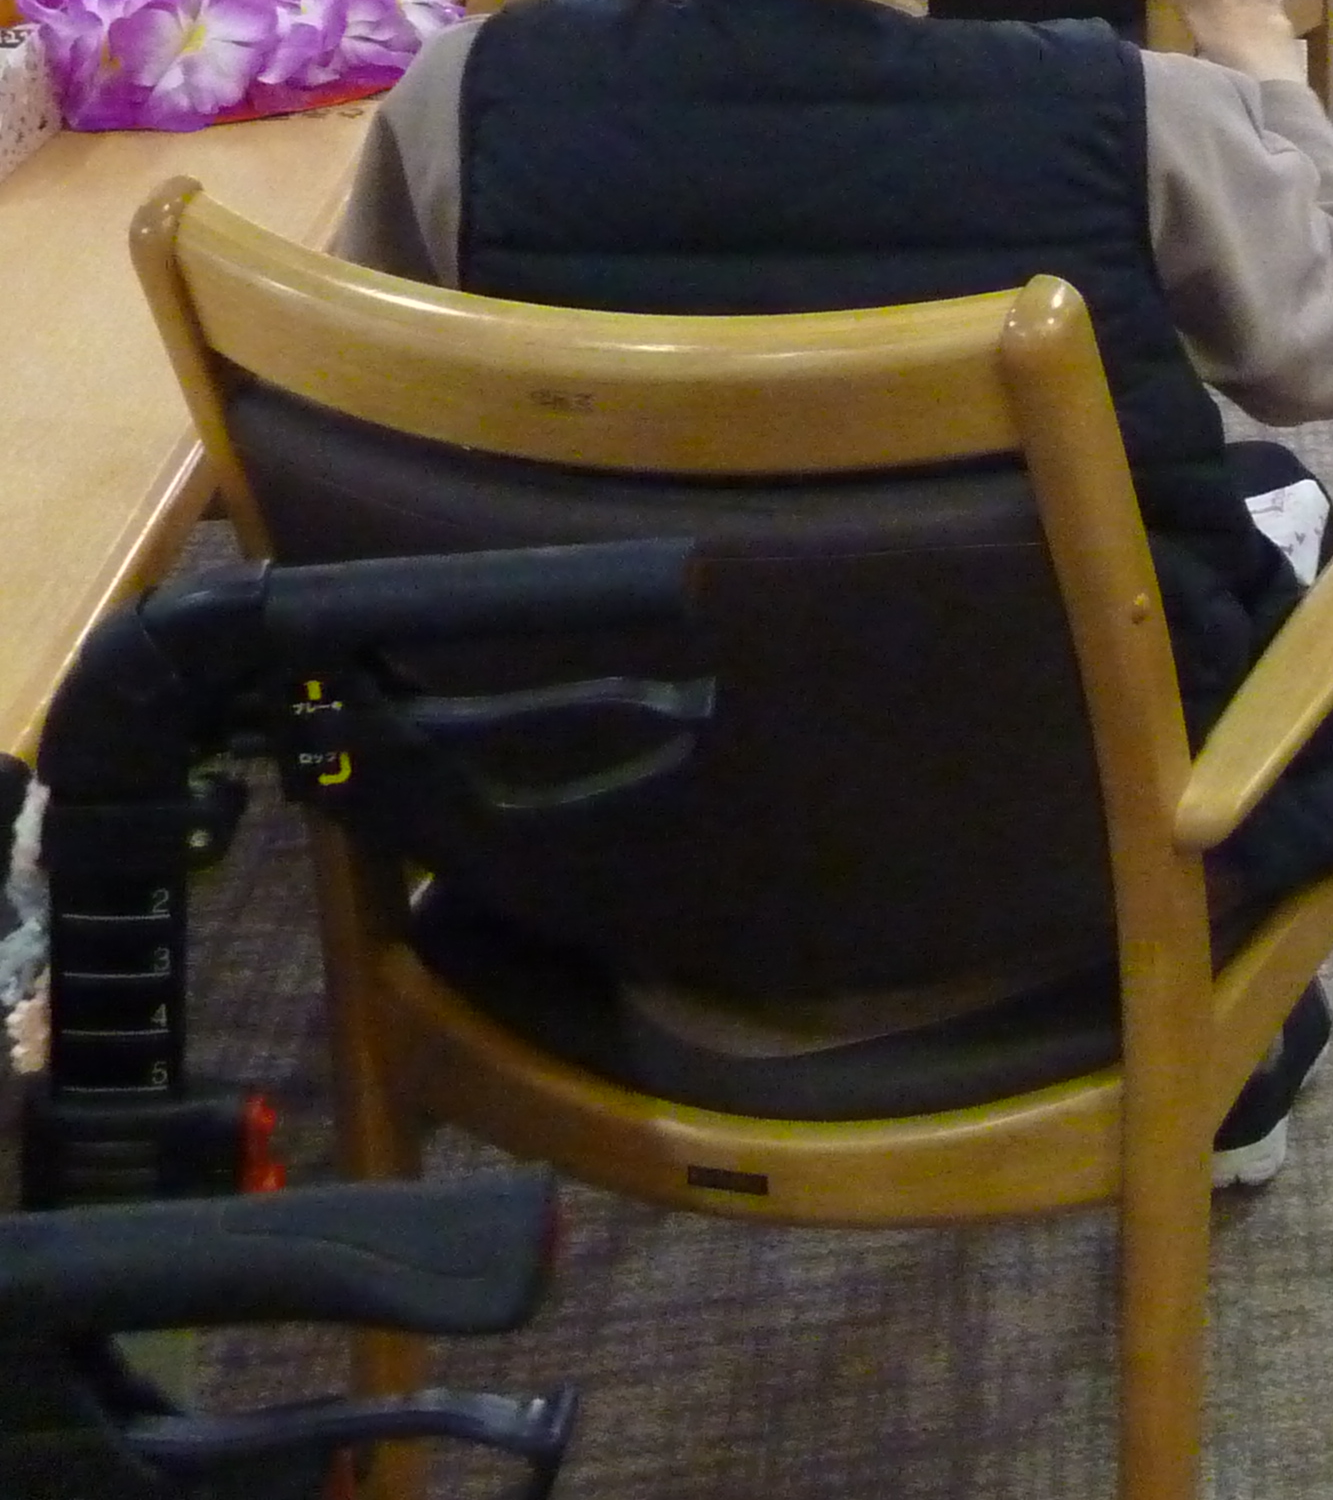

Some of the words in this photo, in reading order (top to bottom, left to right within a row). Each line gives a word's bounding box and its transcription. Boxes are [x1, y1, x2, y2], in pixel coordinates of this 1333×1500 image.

[152, 887, 170, 913] 2
[154, 946, 171, 973] 3
[152, 1003, 168, 1028] 4
[152, 1060, 168, 1085] 5
